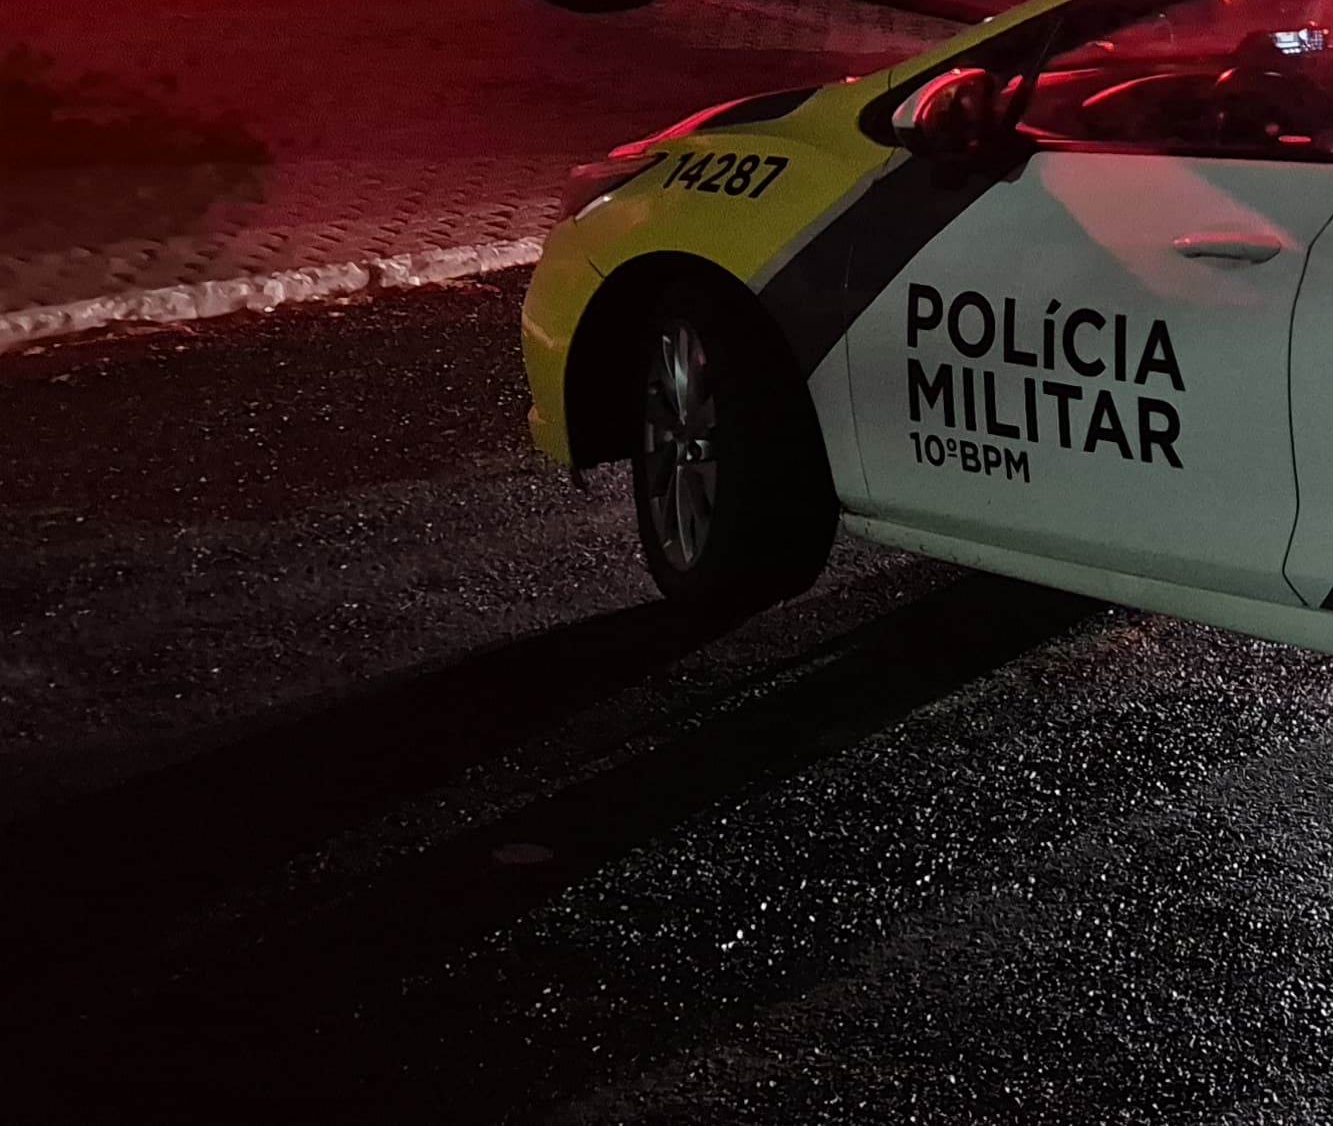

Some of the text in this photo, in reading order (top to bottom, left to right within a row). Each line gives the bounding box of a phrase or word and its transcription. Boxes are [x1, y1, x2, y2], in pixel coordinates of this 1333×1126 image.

[663, 152, 789, 198] 14287
[907, 282, 1186, 392] POLÍCIA
[907, 358, 1184, 469] MILITAR
